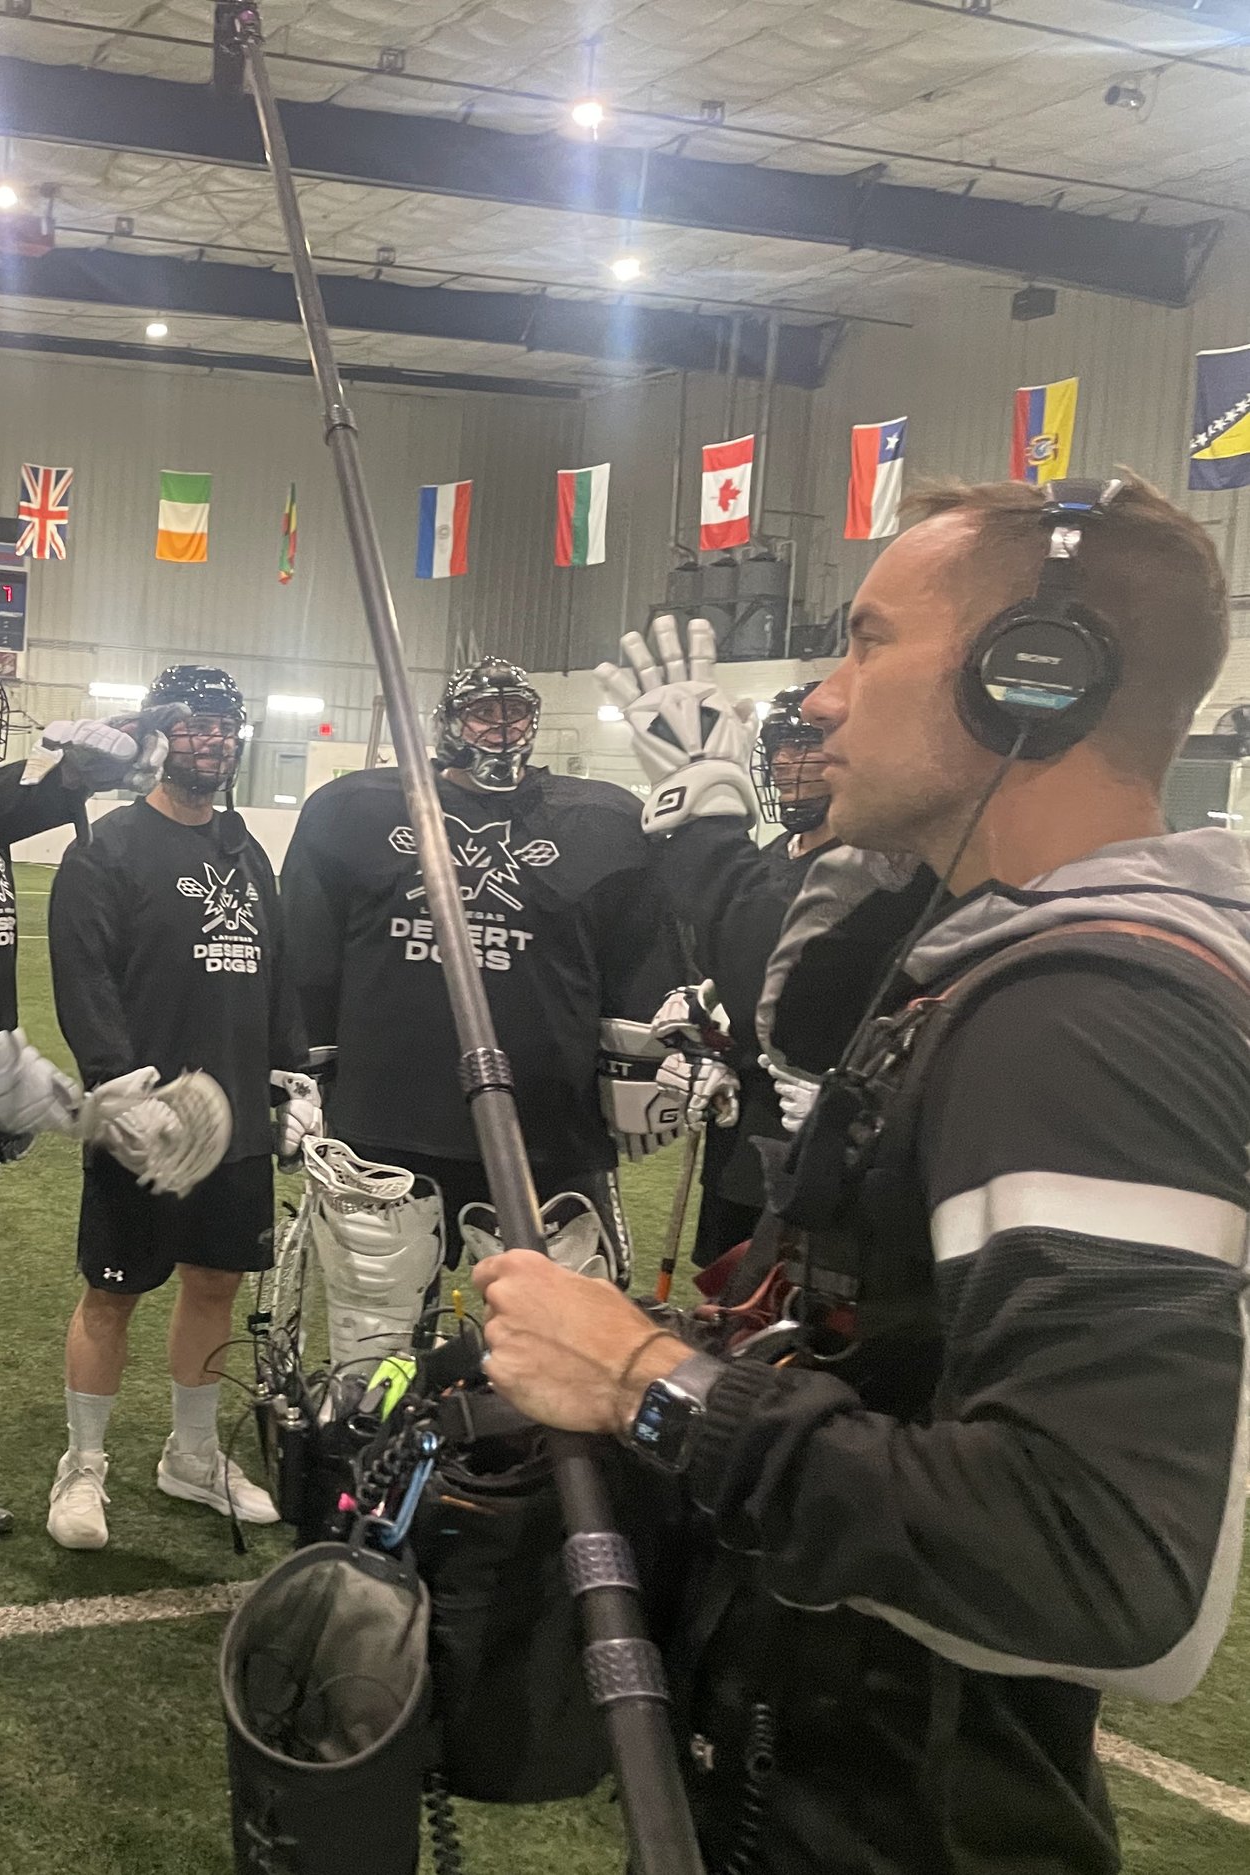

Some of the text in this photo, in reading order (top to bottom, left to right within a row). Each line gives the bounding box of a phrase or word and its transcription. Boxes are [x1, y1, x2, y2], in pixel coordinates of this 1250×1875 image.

[2, 585, 13, 602] 7
[390, 917, 534, 951] DEERT
[193, 943, 261, 960] DESERT
[205, 957, 258, 974] DOGS
